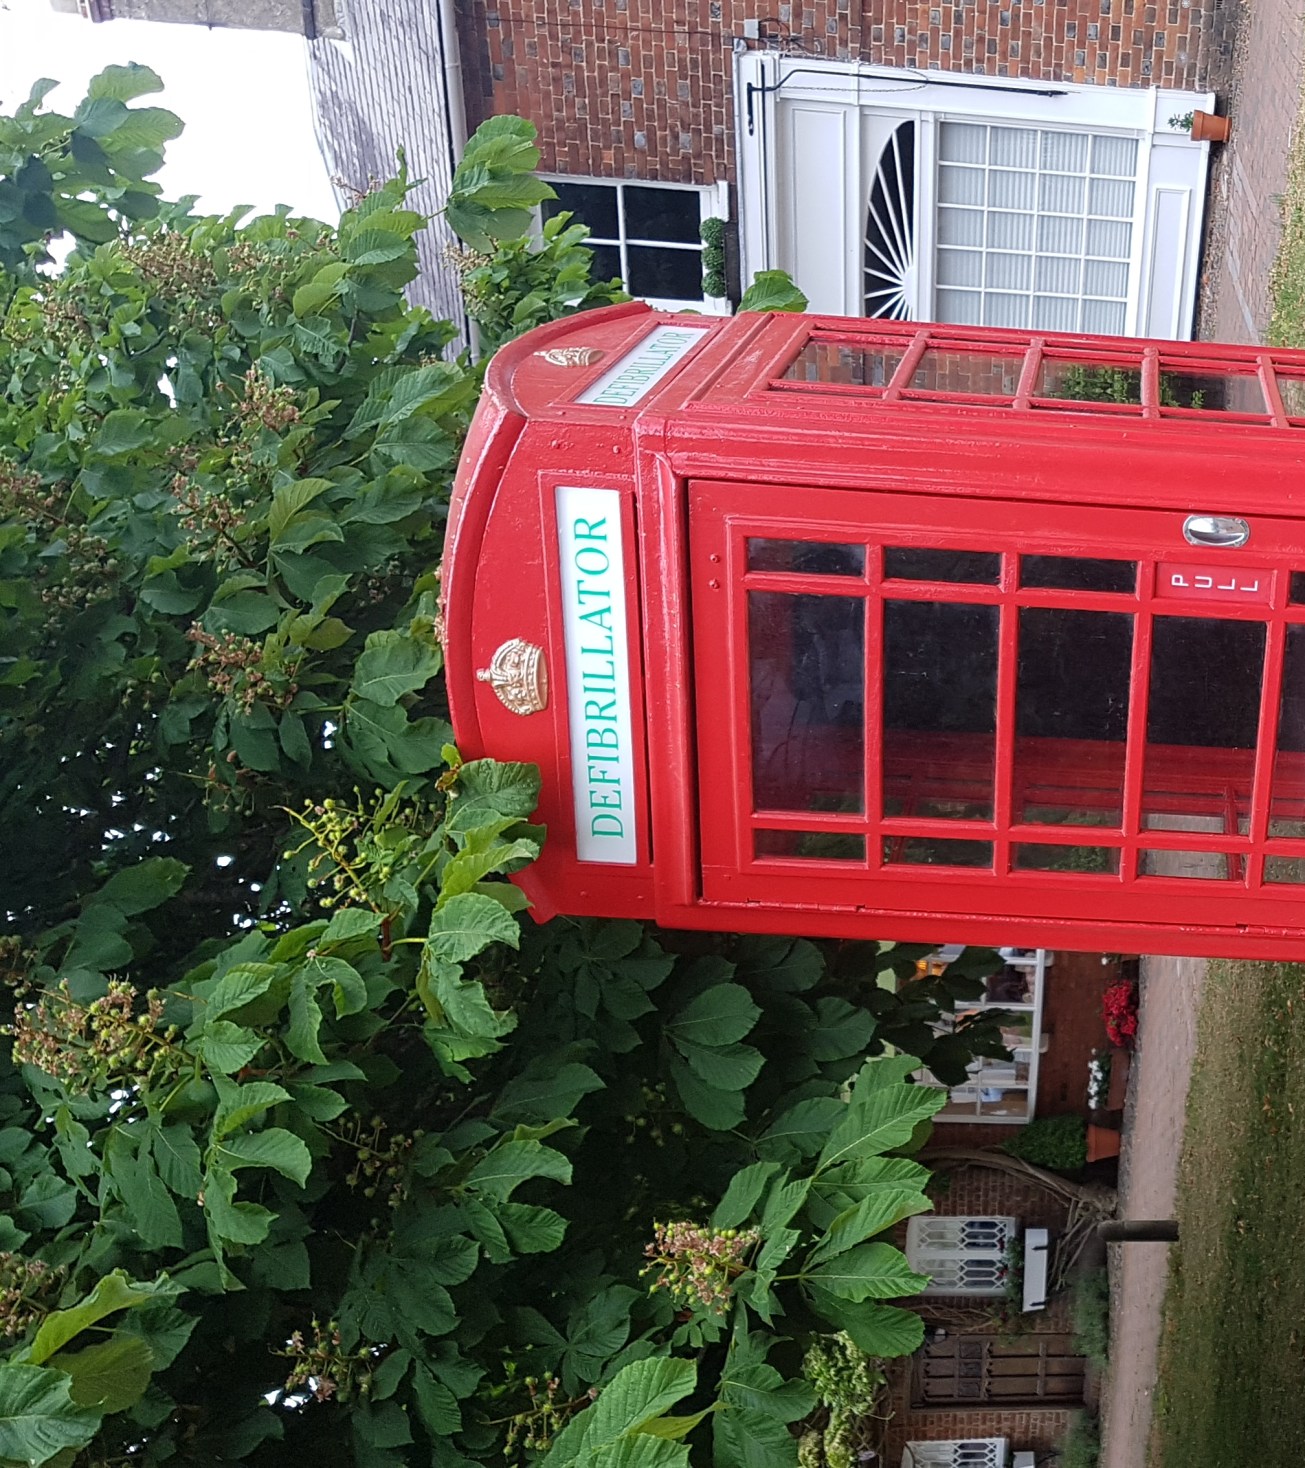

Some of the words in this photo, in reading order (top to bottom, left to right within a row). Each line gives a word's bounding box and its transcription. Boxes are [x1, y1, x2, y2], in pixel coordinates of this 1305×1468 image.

[592, 331, 696, 405] DEFIBRILLATOR
[1171, 574, 1259, 592] PULL
[573, 516, 625, 839] DEFIBRILLATOR
